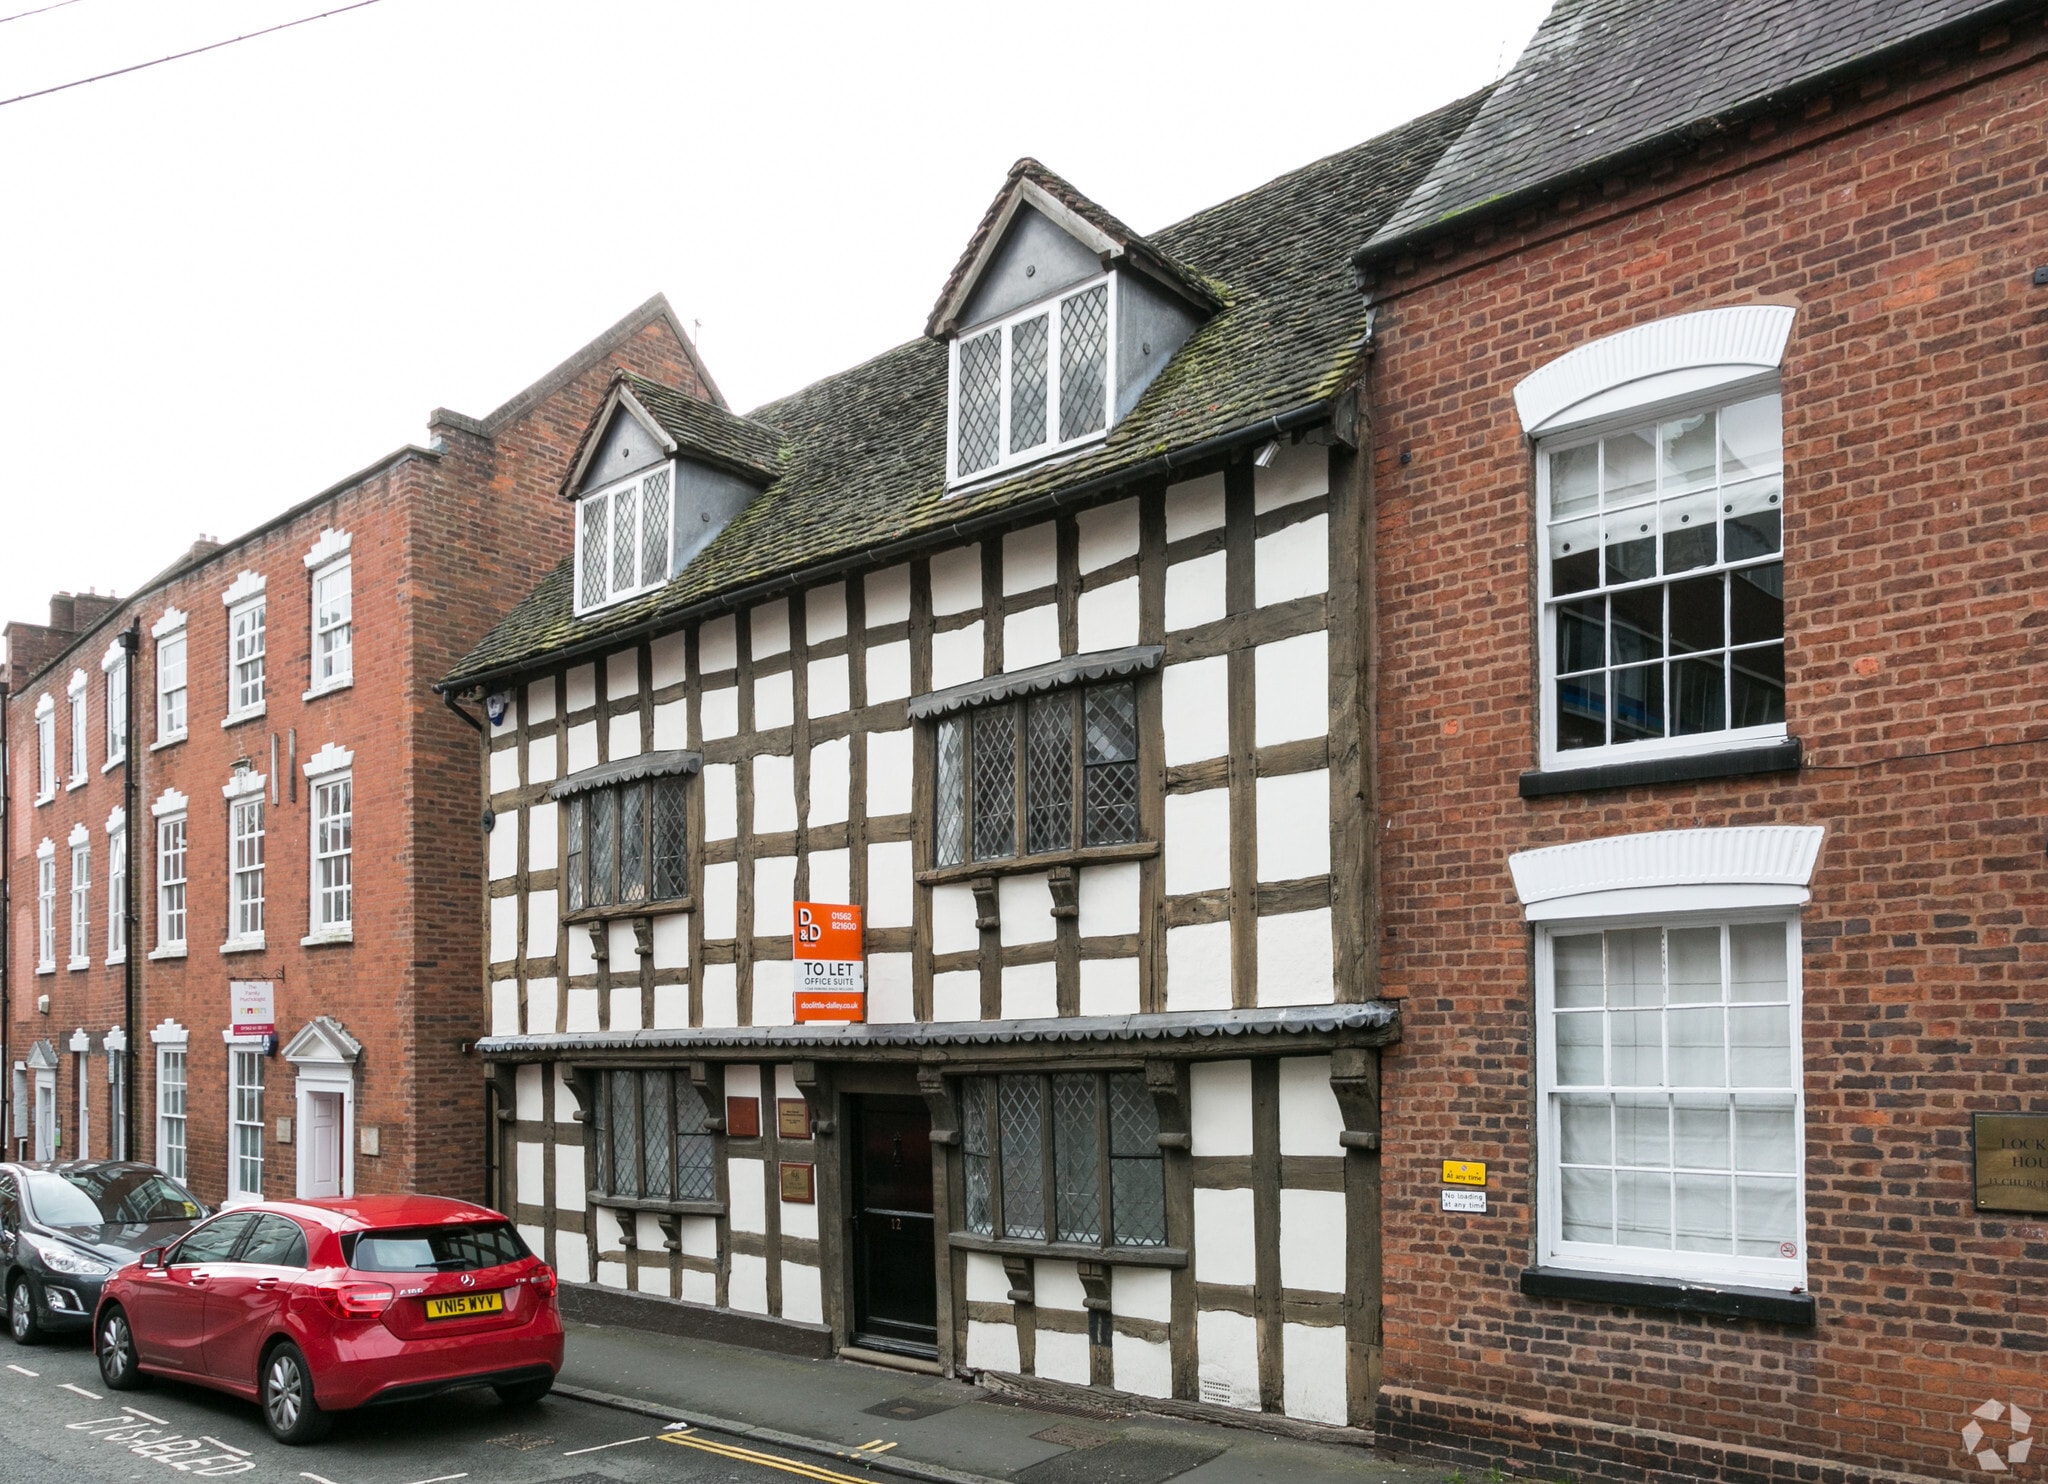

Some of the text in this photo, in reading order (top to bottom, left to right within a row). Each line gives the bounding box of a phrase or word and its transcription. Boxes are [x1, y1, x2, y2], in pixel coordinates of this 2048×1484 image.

[831, 912, 852, 921] 01562
[804, 962, 854, 976] TO LET
[804, 977, 854, 986] OFFICE SUITE
[1457, 1193, 1483, 1201] loading
[435, 1295, 494, 1315] VN15 WYV
[65, 1416, 256, 1476] DISABLED
